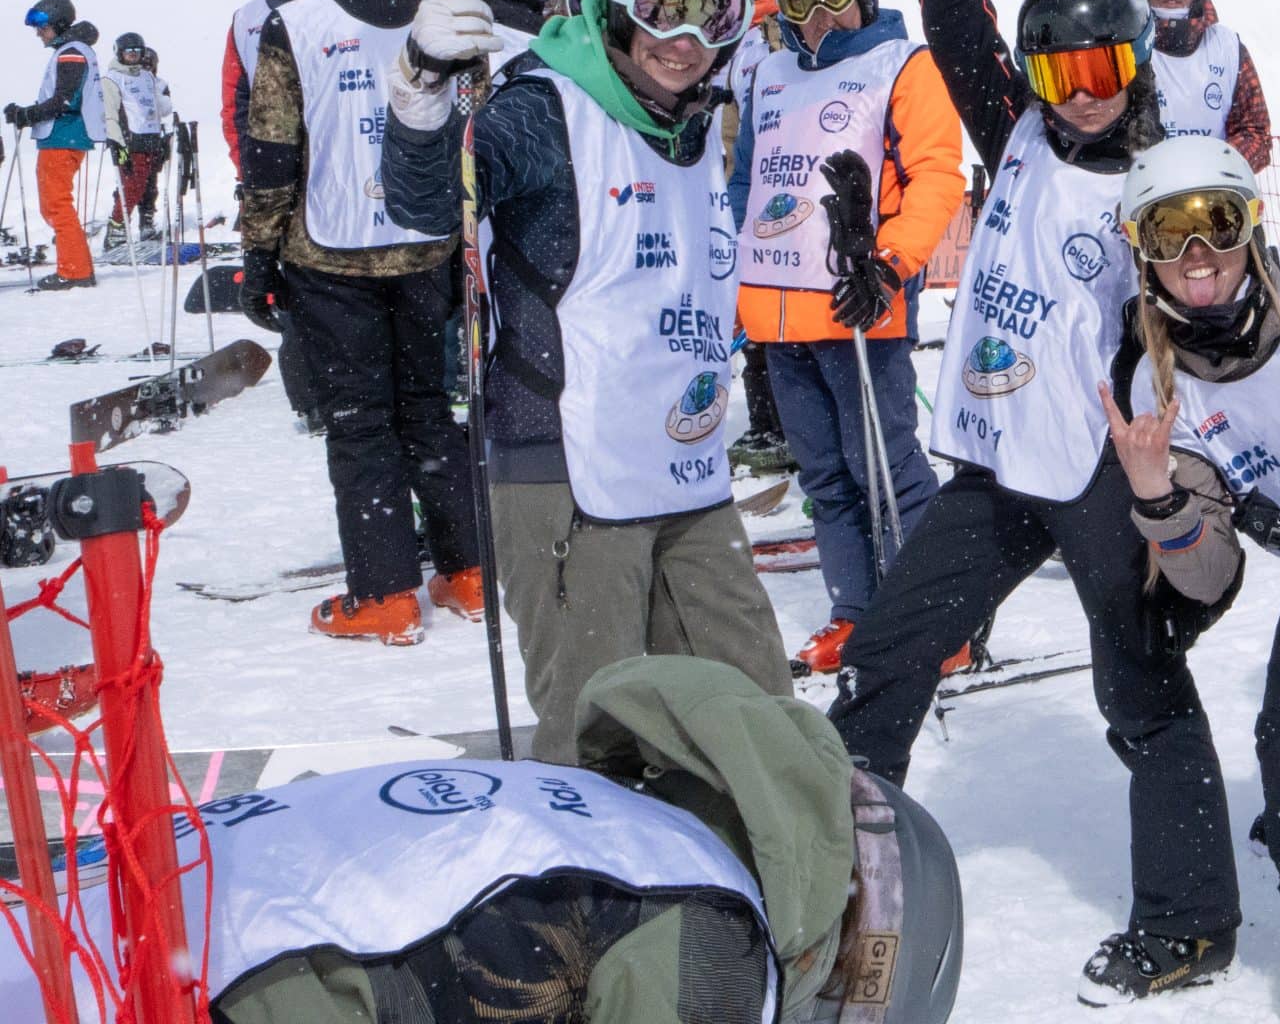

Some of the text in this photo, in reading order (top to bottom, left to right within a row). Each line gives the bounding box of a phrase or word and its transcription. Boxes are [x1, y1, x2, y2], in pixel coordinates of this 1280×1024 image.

[340, 69, 362, 81] HOP
[339, 79, 376, 92] DOWN
[374, 107, 385, 116] LE
[823, 112, 847, 121] piau
[1165, 121, 1176, 129] LE
[771, 146, 782, 155] LE
[760, 154, 819, 175] DERBY
[633, 182, 655, 192] INTER
[773, 173, 808, 188] PIAU
[635, 250, 678, 269] DOWN
[752, 249, 801, 267] N°013
[1068, 246, 1099, 270] piau
[990, 261, 1008, 277] LE
[680, 293, 692, 307] LE
[973, 269, 1057, 322] DERBY
[984, 303, 1038, 340] PIAU
[668, 338, 728, 363] DE PIAU
[1199, 411, 1227, 434] INTER
[1203, 420, 1231, 442] SPORT
[1220, 450, 1252, 476] HOP
[1228, 455, 1280, 492] DOWN
[413, 772, 469, 805] piau
[535, 776, 593, 818] n'py
[1149, 963, 1191, 992] ATOMIC
